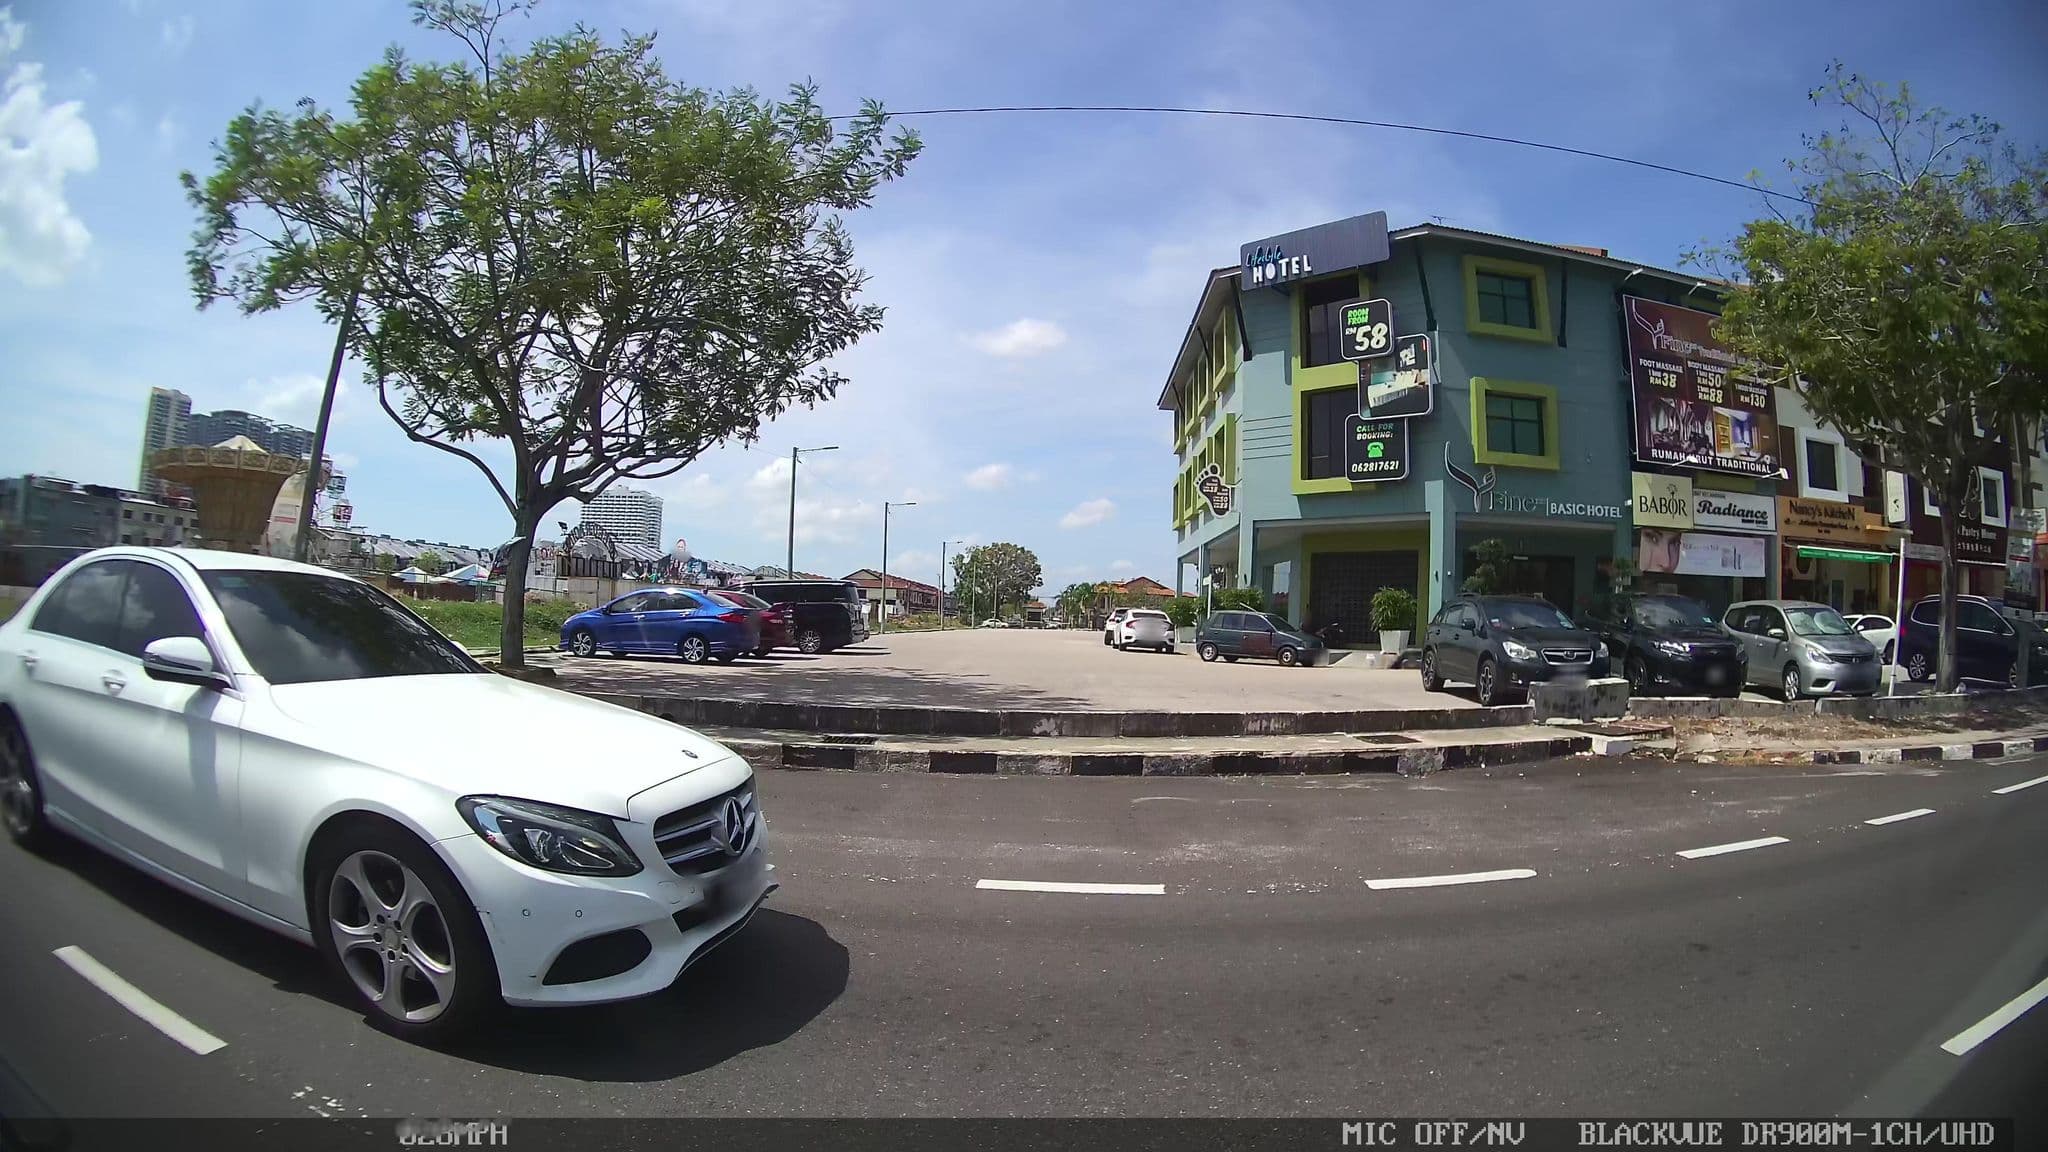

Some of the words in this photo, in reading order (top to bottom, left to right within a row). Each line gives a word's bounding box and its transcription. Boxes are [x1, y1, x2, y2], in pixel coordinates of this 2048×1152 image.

[1253, 254, 1312, 283] HOTEL
[1348, 307, 1369, 318] ROOM
[1348, 316, 1368, 326] FROM
[1354, 322, 1388, 351] 58
[1640, 358, 1655, 369] FOOT
[1656, 360, 1683, 373] MASSAGE
[1661, 372, 1677, 388] 38
[1708, 373, 1721, 388] 50
[1709, 389, 1723, 404] 88
[1750, 393, 1765, 408] 130
[1356, 425, 1375, 433] CALL
[1378, 423, 1393, 431] FOR
[1351, 460, 1399, 473] 062817621
[1651, 449, 1686, 462] RUMAH
[1687, 453, 1713, 466] RUT
[1716, 458, 1771, 473] TRADITIONAL
[1550, 502, 1585, 516] BASIC
[1586, 504, 1623, 518] HOTEL
[1640, 495, 1688, 518] BABOR
[1696, 500, 1768, 520] Radiance
[1789, 500, 1824, 518] Nancy's
